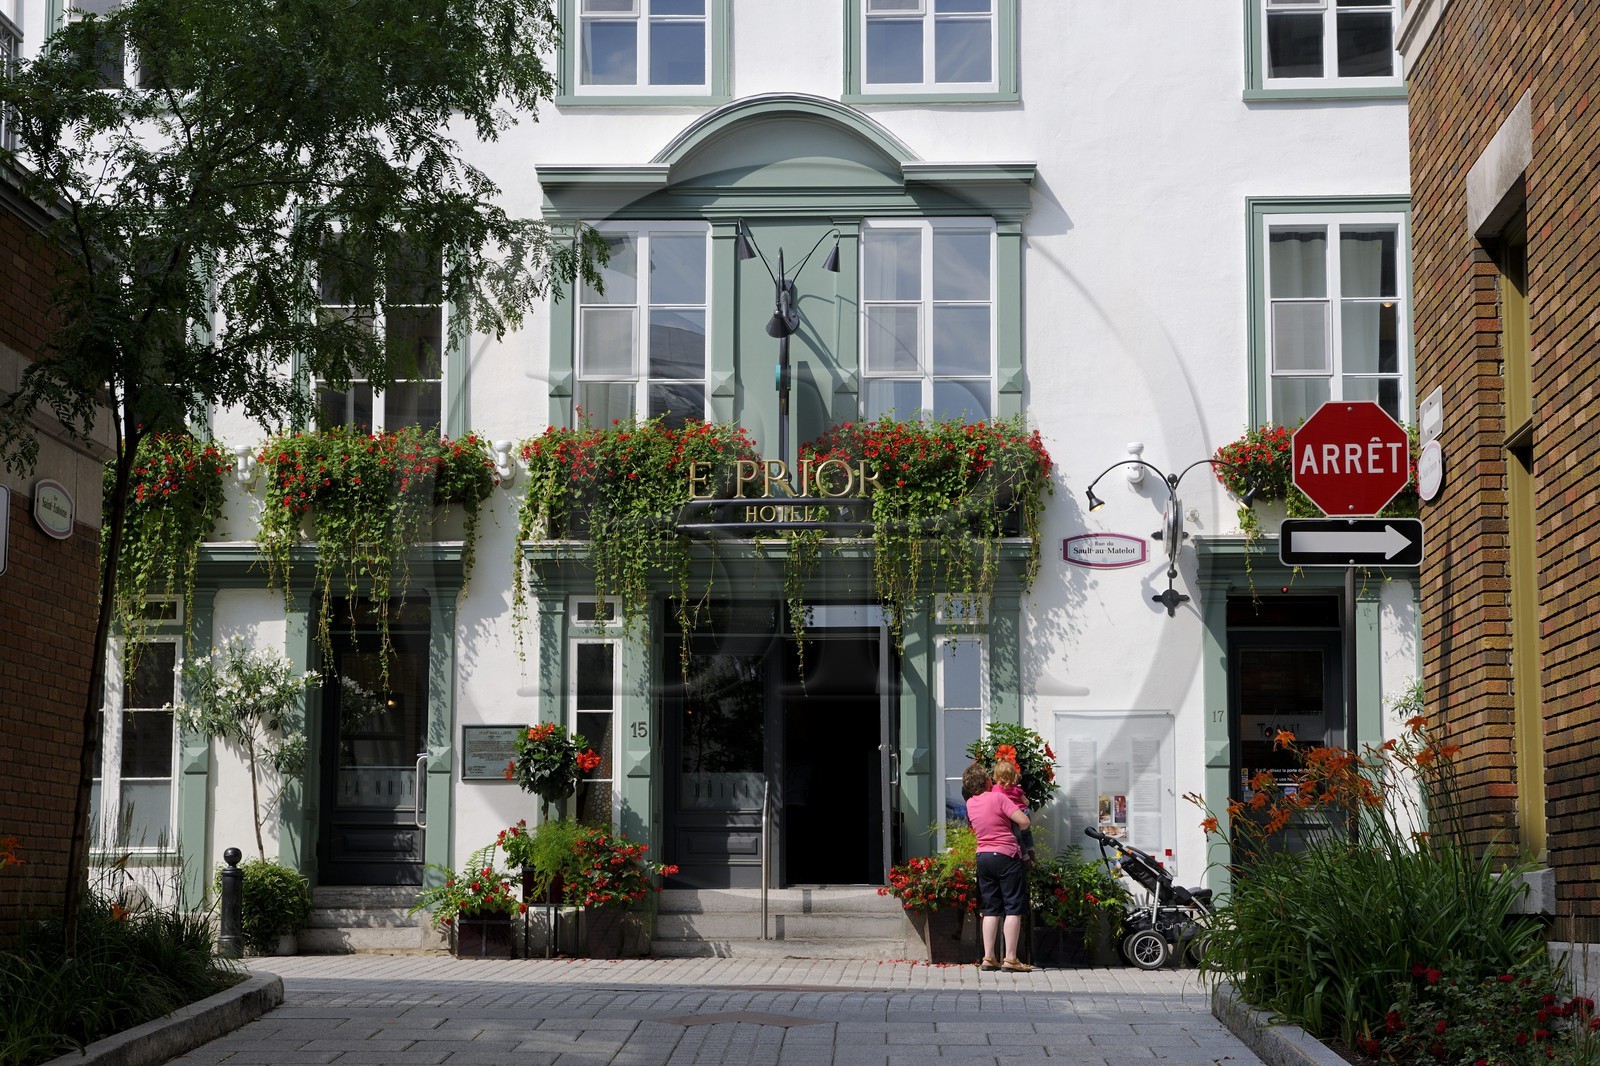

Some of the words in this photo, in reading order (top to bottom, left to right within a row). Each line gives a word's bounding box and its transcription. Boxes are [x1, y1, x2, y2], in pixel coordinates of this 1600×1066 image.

[1299, 436, 1403, 475] ARRÊT
[745, 505, 818, 523] HOTEL
[1073, 547, 1136, 555] Sault-au-Matelot
[1212, 710, 1224, 723] 17
[630, 720, 648, 738] 15
